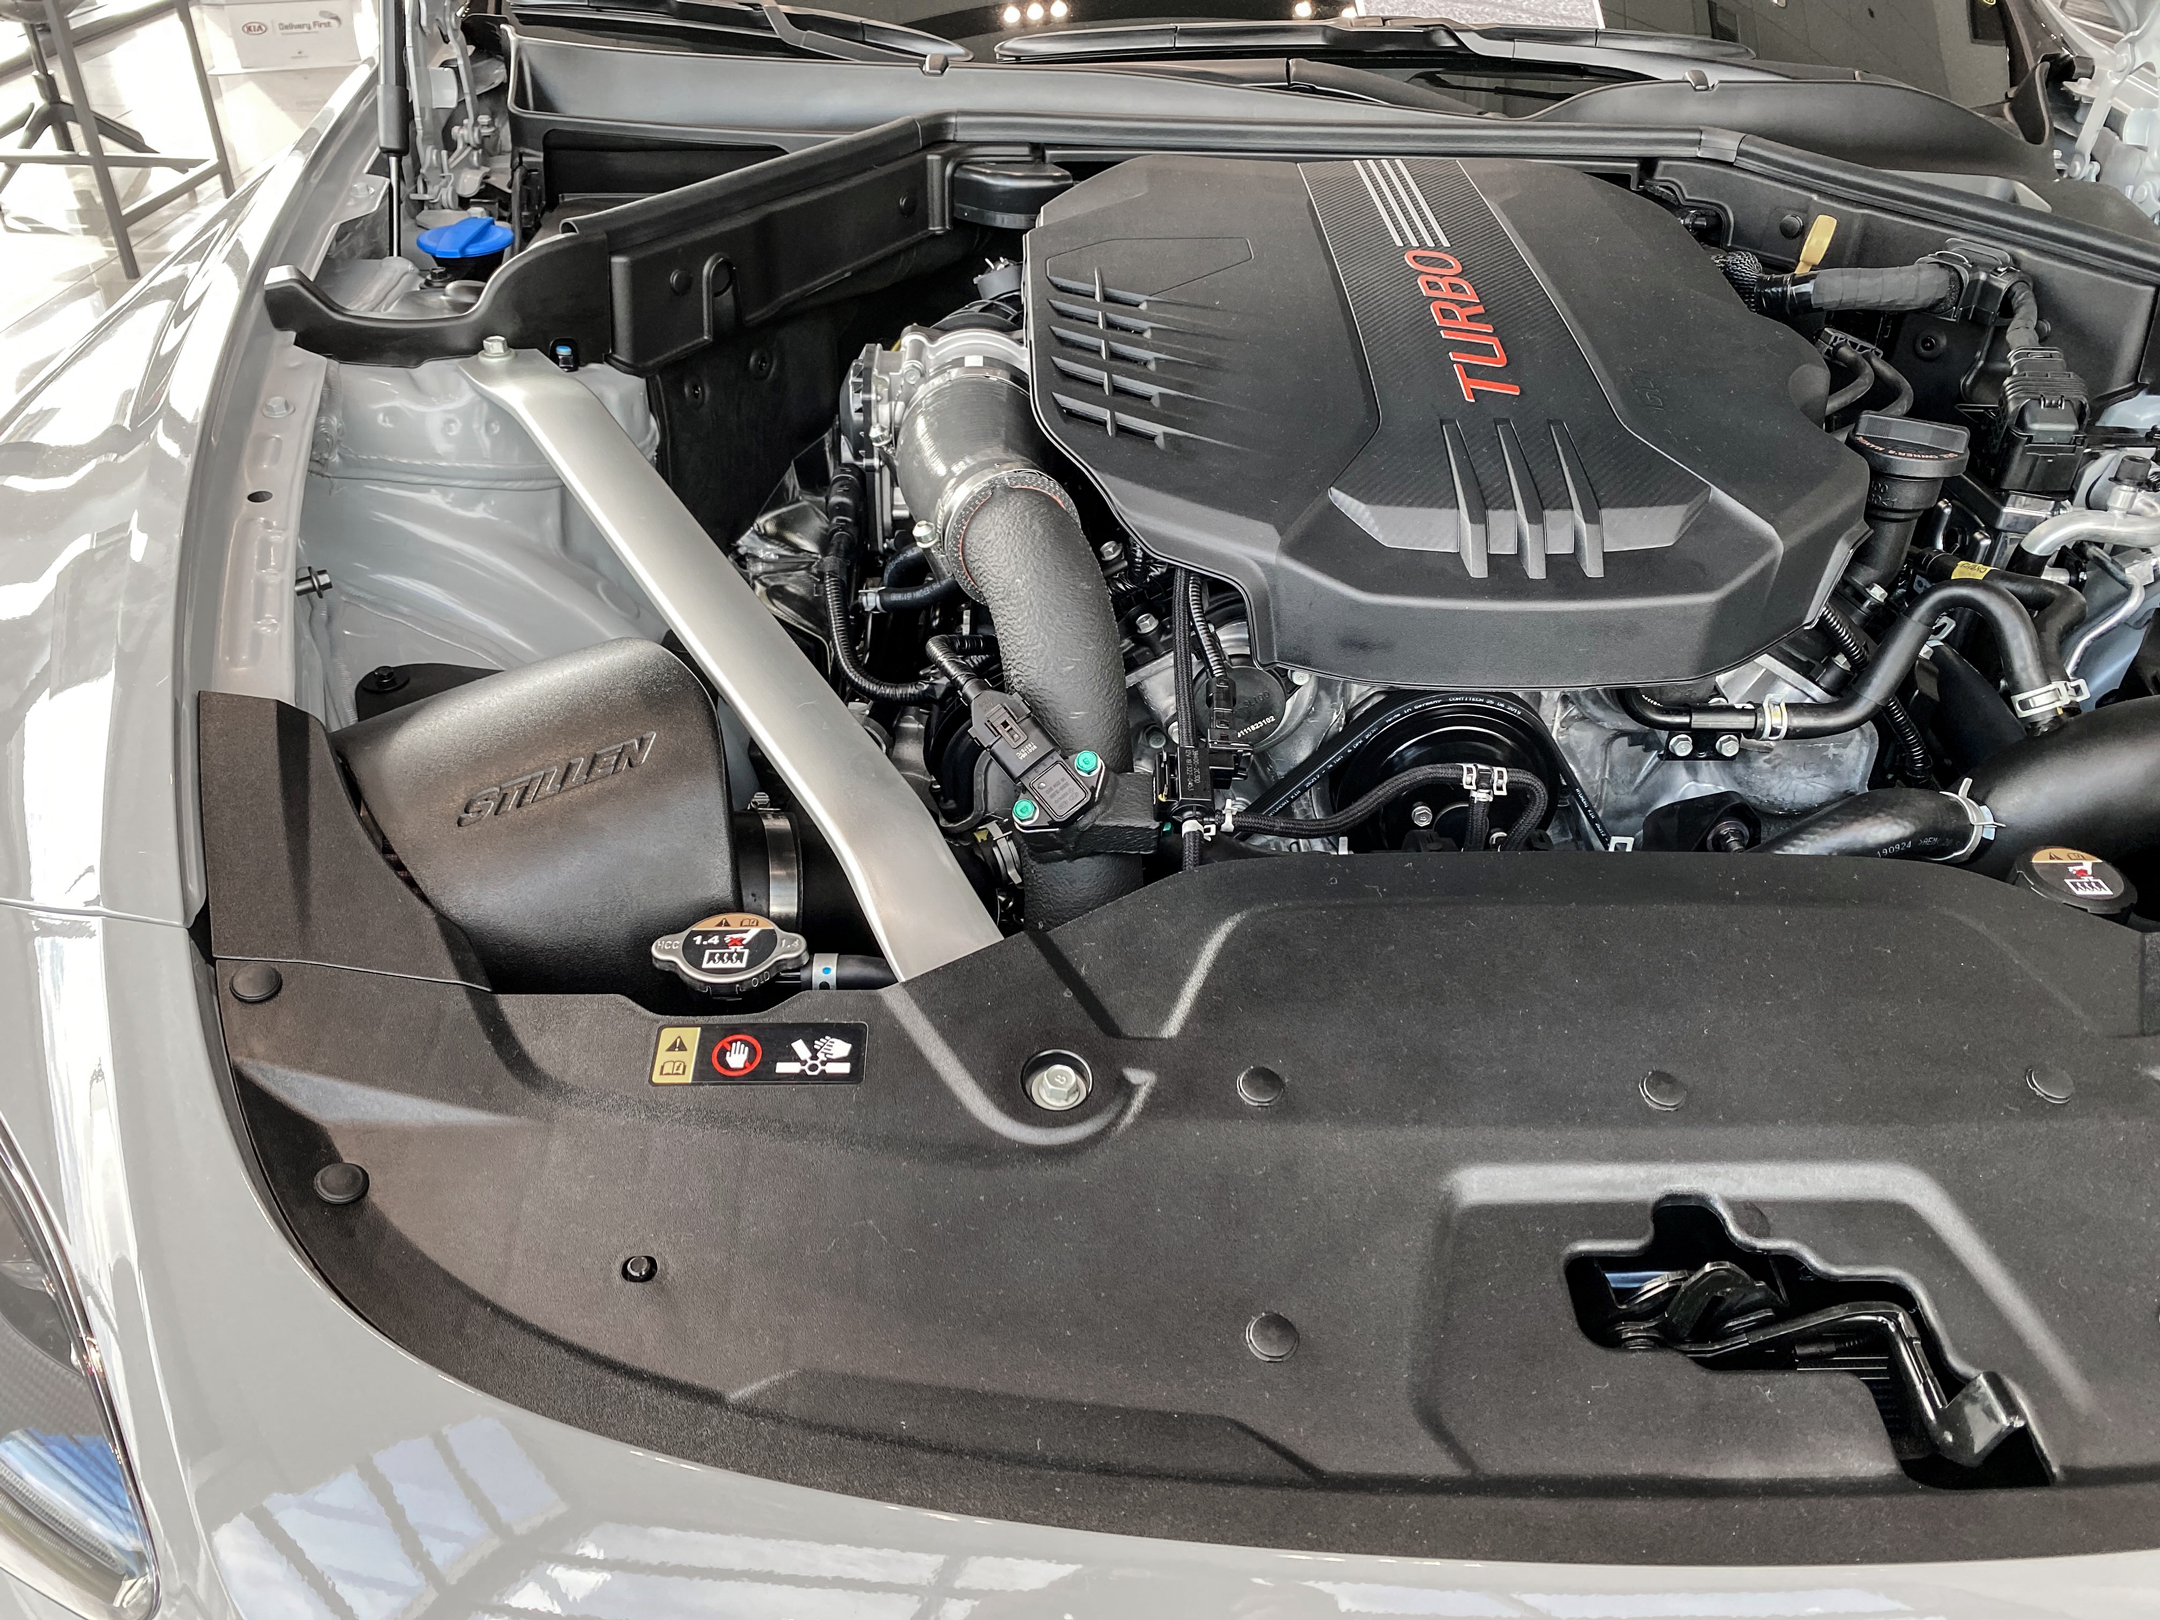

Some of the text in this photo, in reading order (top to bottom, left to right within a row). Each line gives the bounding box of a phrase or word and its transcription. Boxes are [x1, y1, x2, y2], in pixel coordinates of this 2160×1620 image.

[246, 25, 264, 33] KIA
[278, 22, 311, 31] Delivery
[1404, 249, 1520, 402] TURBO
[457, 731, 656, 827] STILLEN
[1877, 841, 1912, 857] 190924
[656, 940, 680, 950] HCC
[693, 935, 720, 946] 1.4
